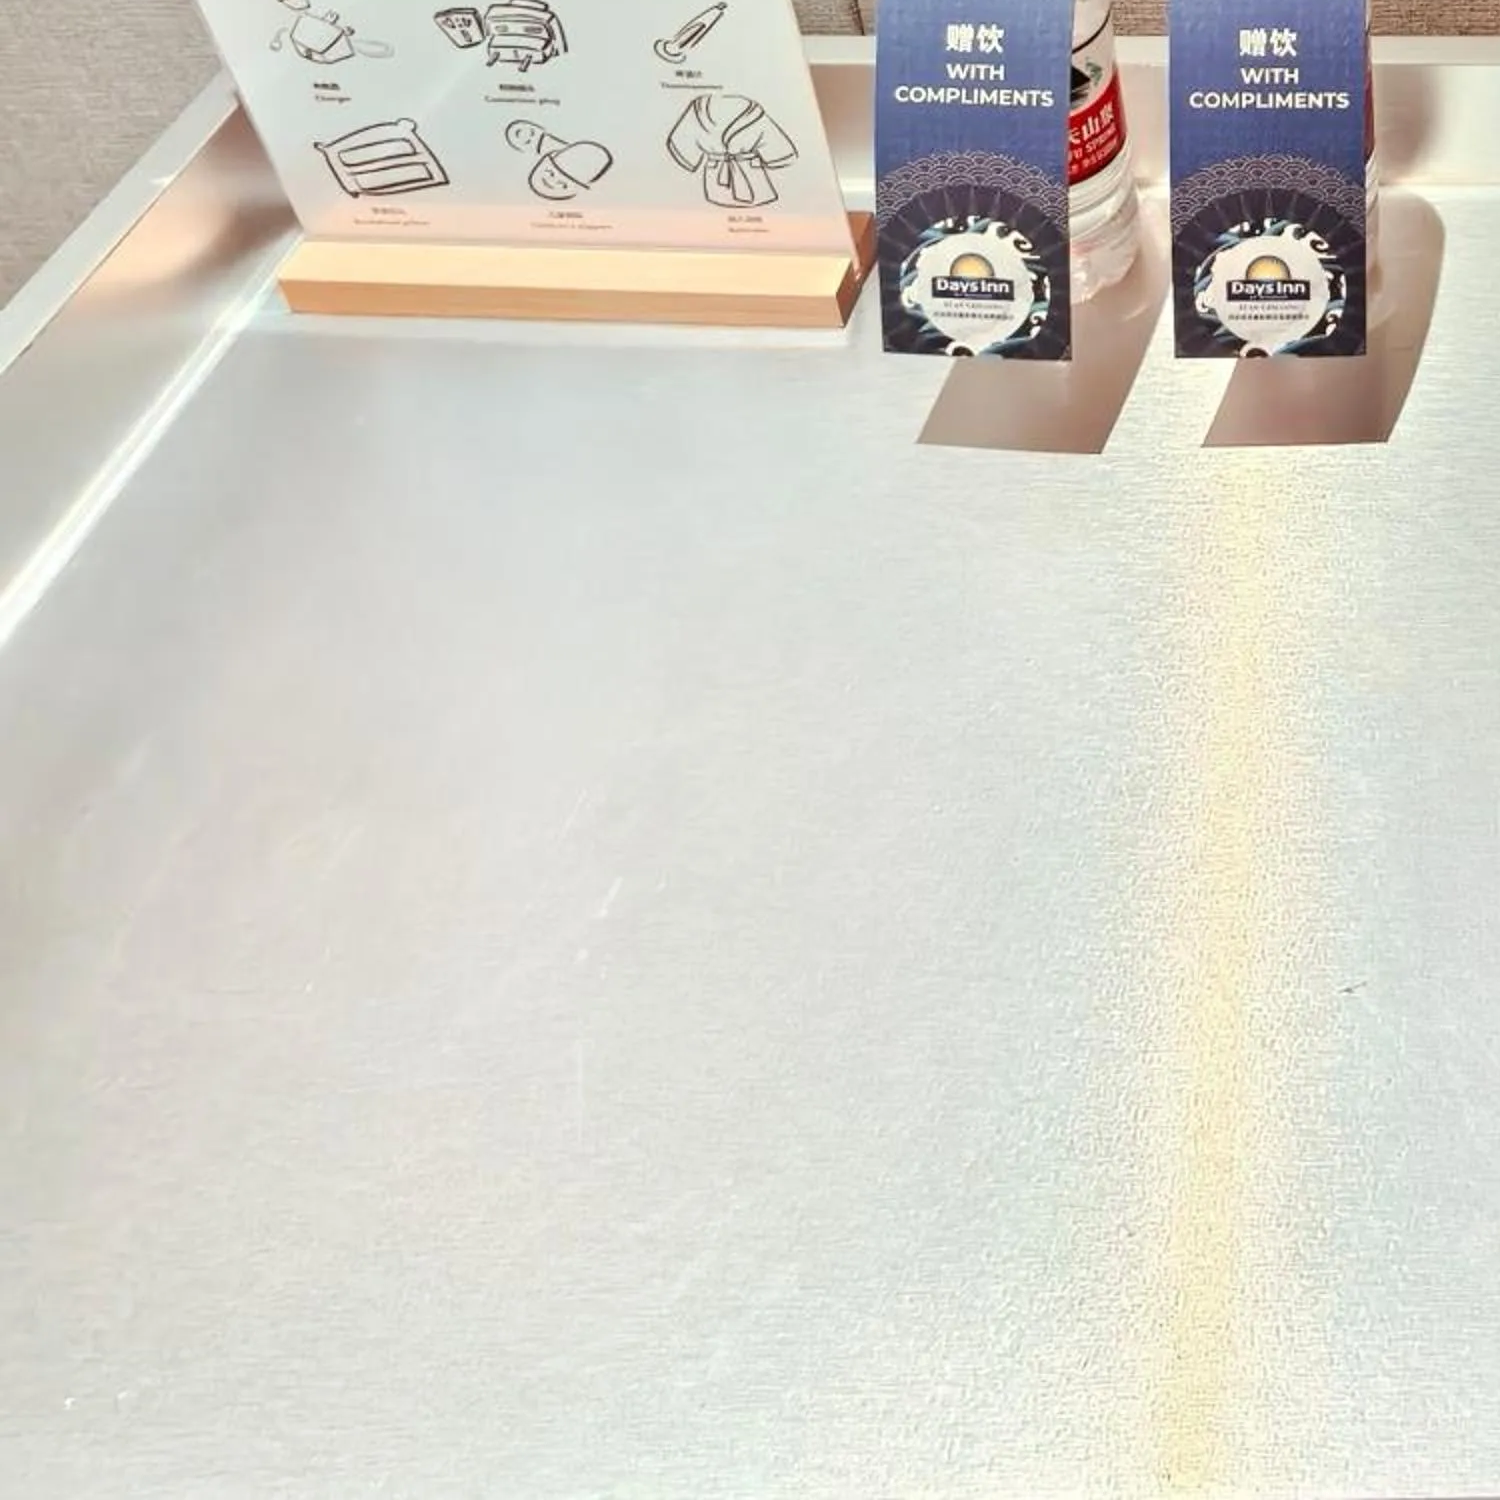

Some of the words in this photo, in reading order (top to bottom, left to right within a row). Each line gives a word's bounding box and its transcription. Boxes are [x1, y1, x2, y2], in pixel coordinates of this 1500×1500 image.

[946, 23, 1004, 53] 赠饮
[1239, 28, 1298, 57] 赠饮
[946, 63, 1005, 81] WITH
[1240, 67, 1299, 84] WITH
[894, 85, 1055, 107] COMPLIMENTS
[1189, 91, 1350, 109] COMPLIMENTS
[936, 279, 979, 293] Days
[981, 280, 1009, 293] Inn
[1231, 281, 1275, 296] Days
[1277, 282, 1306, 294] Inn
